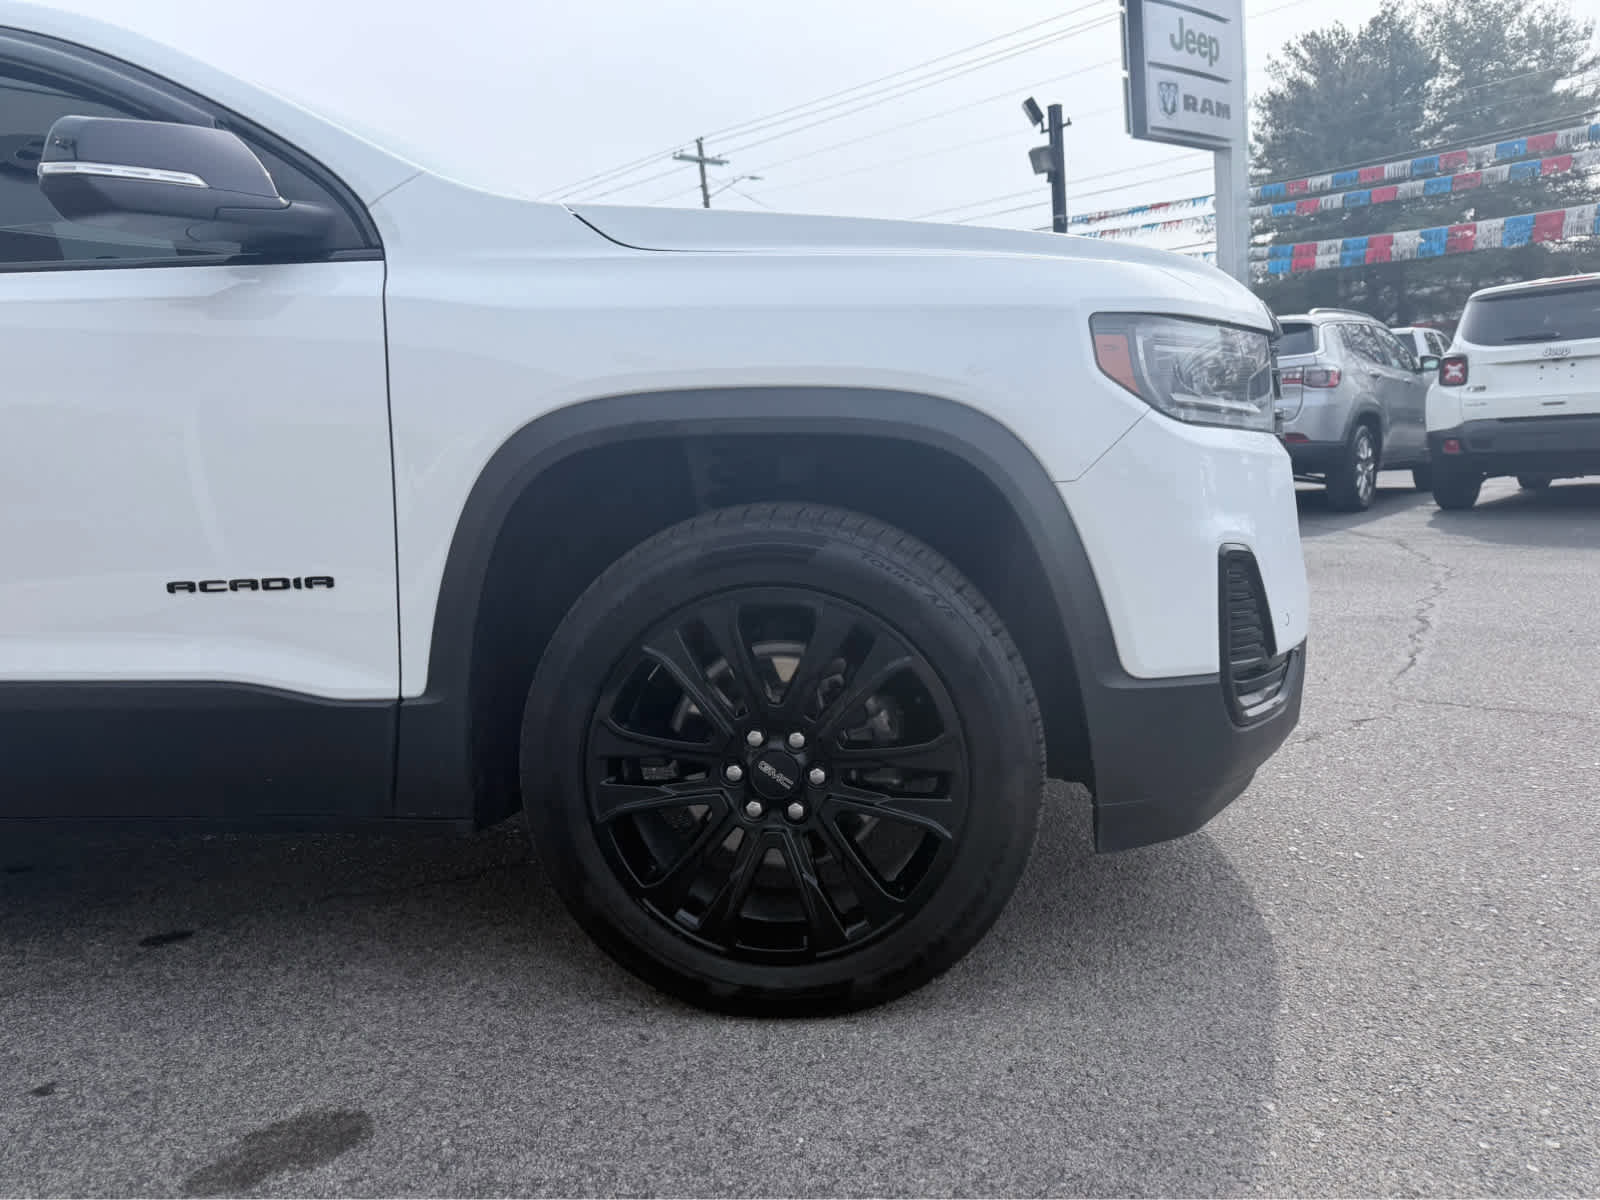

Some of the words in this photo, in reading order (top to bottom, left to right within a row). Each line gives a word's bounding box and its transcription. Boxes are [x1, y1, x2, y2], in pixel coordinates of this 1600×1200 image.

[1169, 17, 1220, 67] Jeep
[1183, 94, 1231, 120] RAM
[166, 576, 335, 594] ACADIA
[758, 760, 794, 789] GMC
